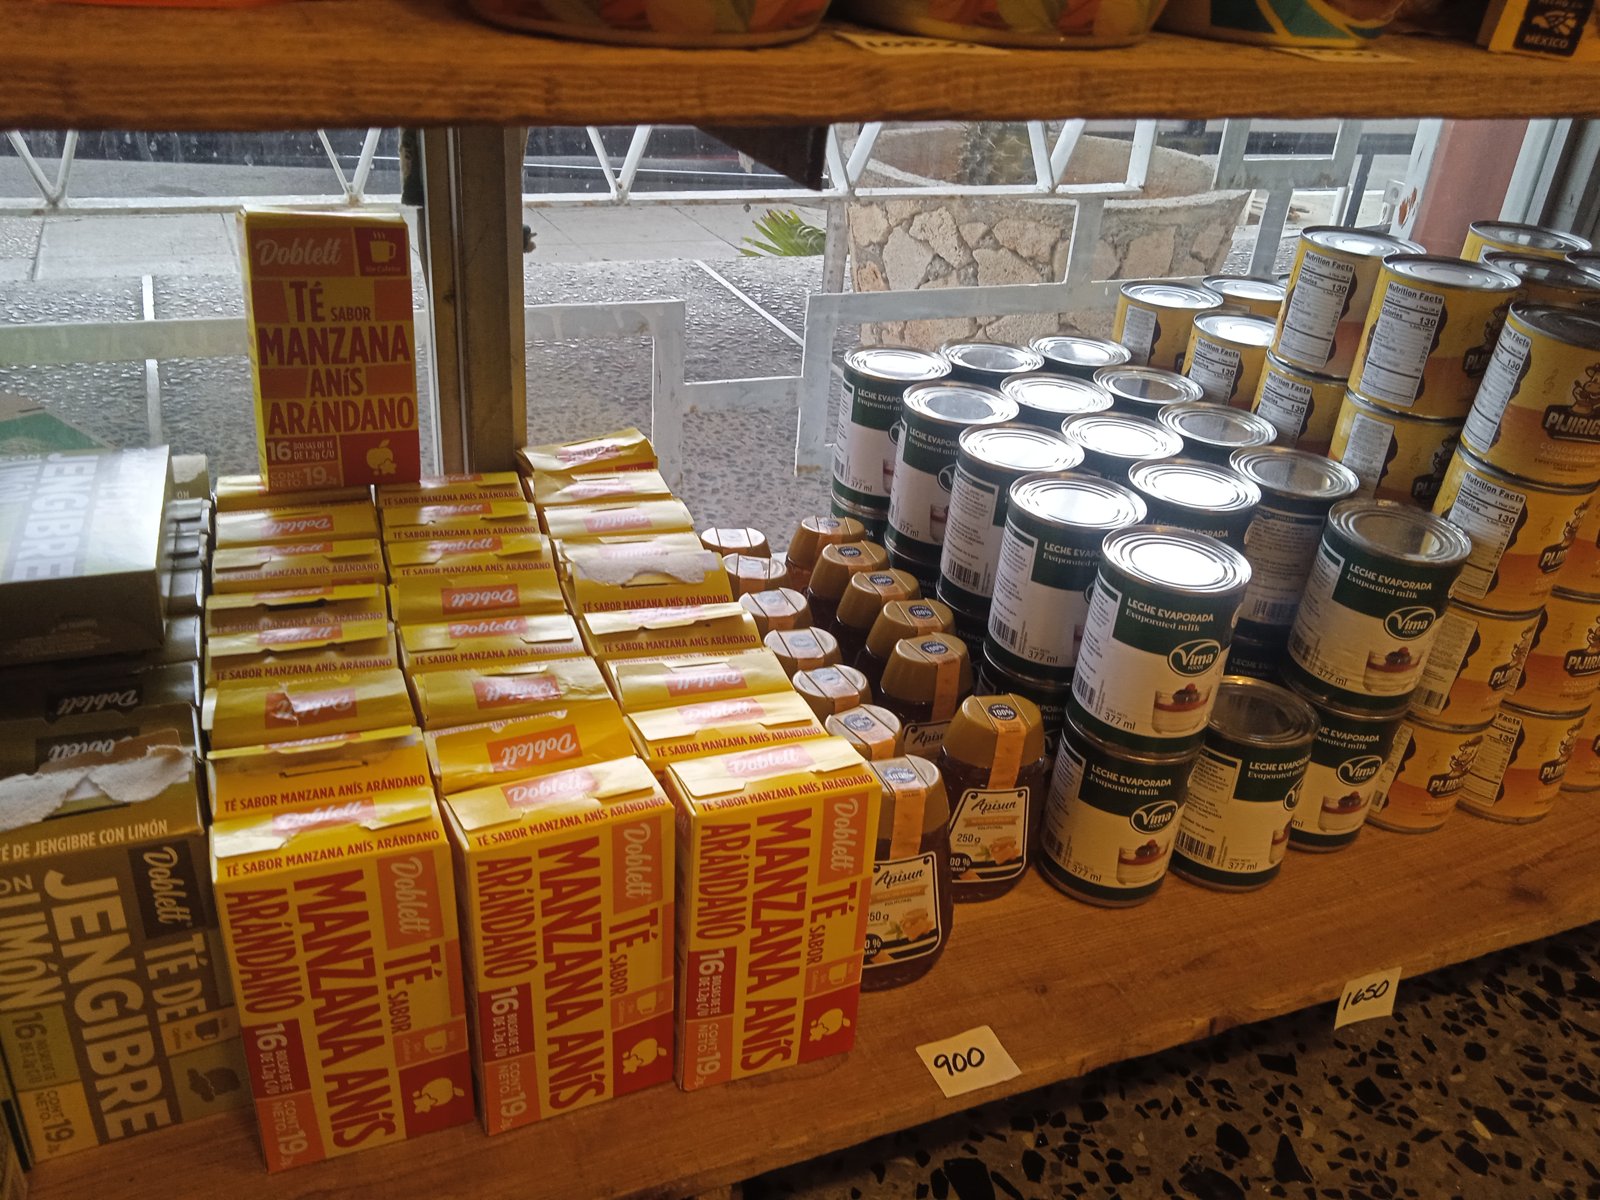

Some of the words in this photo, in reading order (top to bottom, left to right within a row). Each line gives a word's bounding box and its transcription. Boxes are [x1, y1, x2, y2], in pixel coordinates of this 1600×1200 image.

[256, 238, 342, 267] Doblett
[1306, 252, 1330, 268] Nutrition
[1331, 261, 1353, 273] Facts
[289, 281, 325, 323] TÉ
[331, 306, 371, 322] SABOR
[1332, 283, 1347, 293] 130
[1388, 283, 1417, 299] Nutrition
[1419, 293, 1444, 305] Facts
[1419, 316, 1436, 327] 130
[258, 324, 411, 366] MANZANA
[1506, 359, 1521, 371] 130
[309, 367, 364, 398] ANÍS
[268, 396, 415, 435] ARÁNDANO
[1545, 411, 1600, 435] PIJIRIG
[267, 442, 292, 461] 16
[1466, 472, 1498, 495] Nutrition
[1499, 489, 1525, 503] Facts
[1497, 513, 1516, 524] 130
[1349, 563, 1377, 581] LECHE
[1378, 575, 1432, 591] EVAPORADA
[1127, 597, 1156, 615] LECHE
[1157, 608, 1214, 622] EVAPORADA
[1391, 613, 1428, 631] Vima
[615, 642, 644, 652] SABOR
[645, 638, 687, 650] MANZANA
[1028, 650, 1045, 661] 377
[1046, 655, 1059, 663] ml
[1174, 648, 1213, 666] Vima
[1316, 667, 1335, 680] 377
[1335, 676, 1348, 687] ml
[1103, 712, 1122, 724] 377
[1123, 720, 1136, 731] ml
[501, 731, 577, 766] Doblett
[655, 745, 668, 758] TÉ
[670, 743, 700, 756] SABOR
[701, 736, 748, 752] MANZANA
[749, 731, 771, 745] ANÍS
[772, 725, 822, 741] ARÁNDANO
[1091, 764, 1119, 782] LECHE
[1120, 775, 1172, 787] EVAPORADA
[1343, 763, 1376, 778] Vima
[224, 798, 238, 813] TÉ
[240, 796, 278, 810] SABOR
[281, 787, 336, 804] MANZANA
[339, 781, 364, 796] ANÍS
[366, 774, 426, 791] ARÁNDANO
[701, 800, 713, 812] TÉ
[714, 796, 748, 811] SABOR
[749, 787, 798, 806] MANZANA
[799, 781, 821, 795] ANÍS
[822, 774, 873, 791] ARÁNDANO
[971, 798, 1016, 815] Apisun
[477, 835, 490, 847] TÉ
[491, 828, 529, 845] SABOR
[529, 817, 583, 838] MANZANA
[584, 809, 608, 824] ANÍS
[610, 796, 667, 818] ARÁNDANO
[1139, 810, 1172, 825] Vima
[13, 843, 31, 859] DE
[33, 831, 96, 856] JENGIBRE
[100, 827, 125, 845] CON
[128, 819, 168, 841] LIMÓN
[830, 798, 859, 873] Doblett
[956, 833, 974, 844] 250
[225, 863, 241, 878] TÉ
[242, 852, 283, 874] SABOR
[285, 844, 344, 867] MANZANA
[347, 839, 374, 855] ANÍS
[377, 830, 439, 850] ARÁNDANO
[623, 822, 653, 898] Doblett
[1228, 862, 1245, 870] 377
[143, 846, 190, 925] Doblett
[695, 823, 752, 940] ARÁNDANO
[875, 868, 925, 887] Apisun
[1071, 864, 1088, 878] 377
[1089, 872, 1102, 882] ml
[390, 856, 430, 936] Doblett
[746, 808, 813, 993] MANZANA
[810, 881, 857, 924] TÉ
[476, 856, 539, 978] ARÁNDANO
[538, 836, 605, 1030] MANZANA
[609, 908, 659, 954] TÉ
[144, 931, 208, 979] TÉ
[224, 888, 305, 1014] ARÁNDANO
[806, 924, 825, 965] SABOR
[294, 868, 385, 1068] MANZANA
[384, 945, 442, 990] TÉ
[610, 954, 628, 997] SABOR
[698, 949, 725, 975] 16
[44, 869, 172, 1140] JENGIBRE
[155, 980, 207, 1023] DE
[491, 987, 520, 1014] 16
[1342, 979, 1390, 1011] 1650
[13, 1011, 47, 1039] 16
[388, 991, 412, 1033] SABOR
[256, 1022, 288, 1049] 16
[740, 997, 798, 1071] ANÍS
[546, 1029, 606, 1109] ANÍS
[933, 1046, 985, 1077] 900
[324, 1067, 397, 1148] ANÍS
